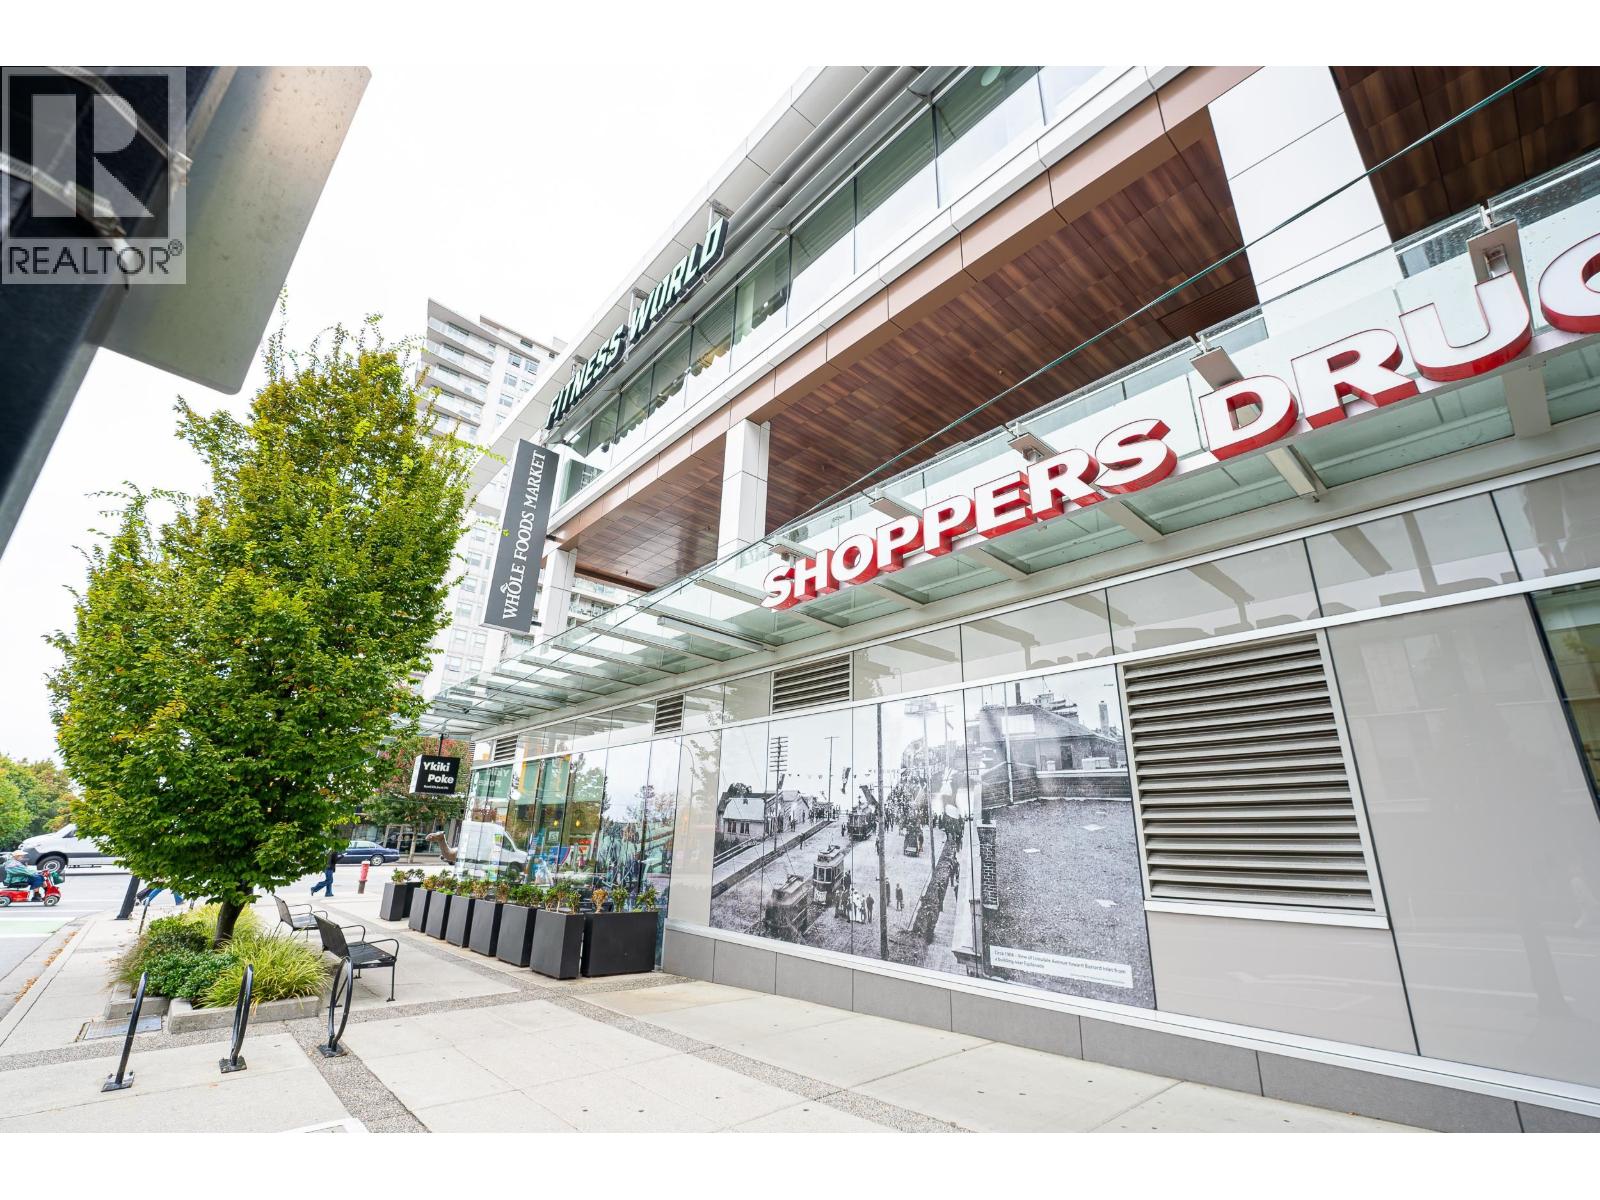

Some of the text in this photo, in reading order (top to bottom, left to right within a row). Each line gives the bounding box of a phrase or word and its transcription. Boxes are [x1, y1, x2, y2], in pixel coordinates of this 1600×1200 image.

[545, 217, 729, 430] FITNESS WORLD
[501, 450, 546, 620] WHOLE FOODS MARKET
[761, 418, 1178, 611] SHOPPERS
[423, 762, 450, 772] Ykiki
[427, 774, 454, 784] Poke
